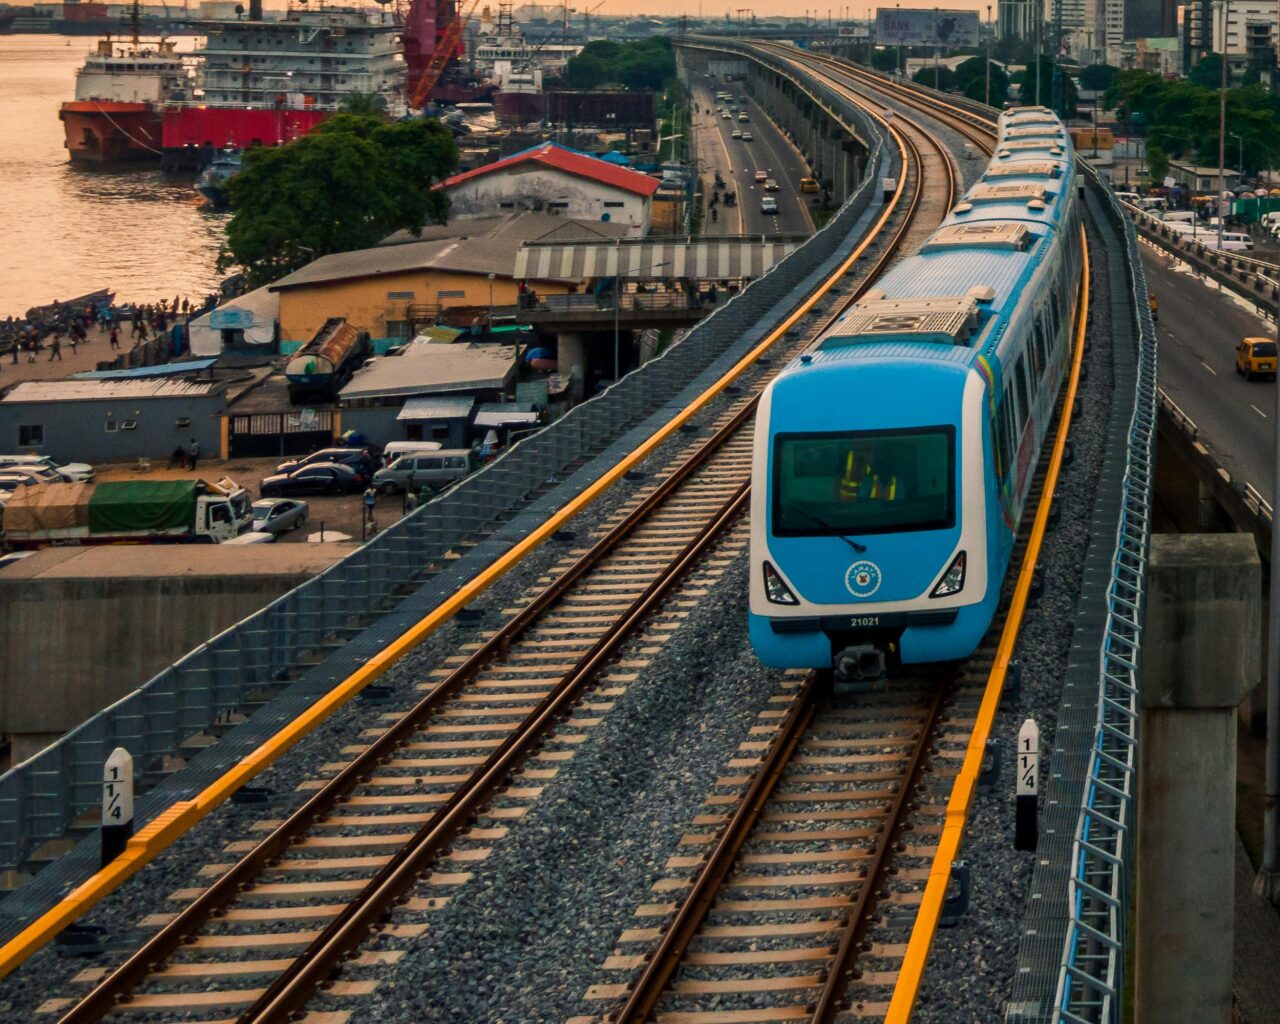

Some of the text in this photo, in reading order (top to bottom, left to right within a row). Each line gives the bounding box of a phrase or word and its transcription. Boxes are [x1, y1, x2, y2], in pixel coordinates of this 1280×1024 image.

[851, 617, 880, 627] 21021
[1023, 738, 1031, 751] 1
[109, 766, 118, 780] 1
